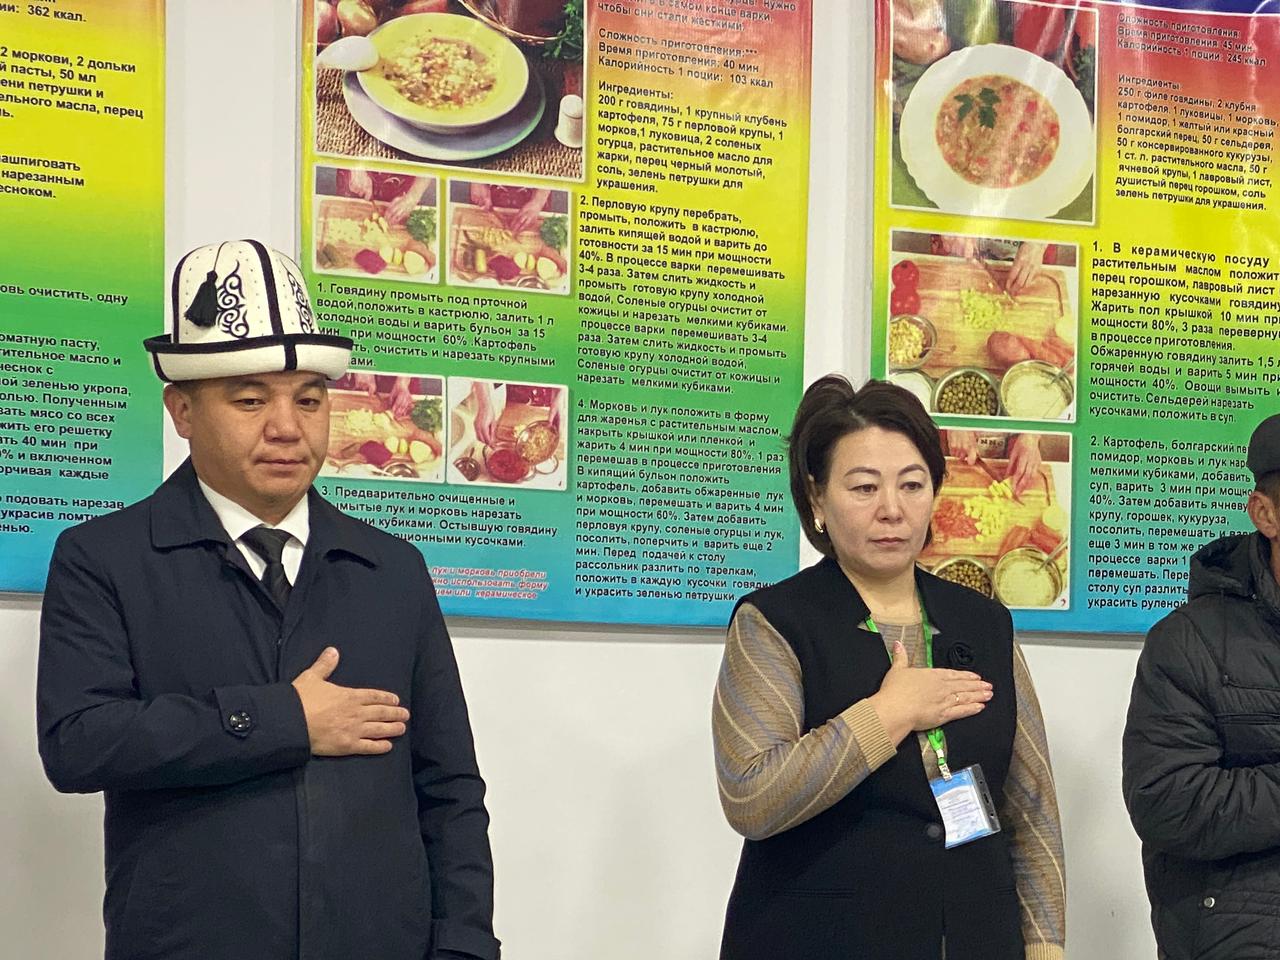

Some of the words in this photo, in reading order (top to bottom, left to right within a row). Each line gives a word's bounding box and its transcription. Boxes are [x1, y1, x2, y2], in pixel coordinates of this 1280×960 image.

[26, 6, 50, 18] 362
[52, 10, 87, 22] ккал.
[0, 47, 8, 57] 2
[11, 50, 73, 67] моркови,
[75, 56, 85, 67] 2
[86, 59, 136, 73] дольки
[10, 65, 56, 79] пасты,
[58, 69, 75, 80] 50
[77, 73, 96, 82] мл
[27, 82, 92, 97] петрушки
[95, 90, 104, 98] и
[598, 80, 673, 99] Ингредиенты:
[55, 100, 100, 114] масла,
[103, 106, 144, 119] перец
[597, 94, 616, 107] 200
[618, 99, 624, 108] г
[625, 100, 683, 116] говядины,
[685, 105, 691, 116] 1
[743, 114, 788, 127] клубень
[597, 110, 659, 126] картофеля,
[662, 115, 675, 127] 75
[676, 119, 682, 128] г
[683, 120, 737, 134] перловой
[738, 127, 775, 141] крупы,
[778, 130, 783, 140] 1
[647, 129, 703, 145] луковица,
[704, 134, 712, 145] 2
[714, 137, 762, 151] соленых
[596, 137, 636, 151] огурца,
[638, 142, 714, 159] растительное
[716, 151, 750, 163] масло
[751, 155, 773, 165] для
[634, 155, 668, 168] перец
[714, 164, 765, 180] молотый,
[1, 170, 84, 186] нарезанным
[596, 165, 625, 177] соль,
[627, 168, 666, 180] зелень
[668, 172, 720, 186] петрушки
[721, 178, 743, 189] для
[596, 178, 658, 193] украшения.
[1092, 240, 1103, 252] 1.
[1112, 242, 1121, 253] В
[1130, 246, 1216, 263] керамическую
[1224, 253, 1270, 268] посуду
[1091, 258, 1177, 273] растительным
[1184, 265, 1221, 276] маслом
[1091, 272, 1126, 285] перец
[1128, 275, 1189, 290] горошком,
[1191, 280, 1243, 293] лавровый
[1246, 284, 1276, 295] лист
[27, 287, 93, 302] очистить,
[96, 293, 128, 305] одну
[316, 282, 327, 293] 1.
[329, 283, 387, 300] Говядину
[389, 290, 444, 302] промыть
[446, 294, 470, 306] под
[1091, 287, 1160, 303] нарезанную
[1169, 293, 1221, 305] кусочками
[68, 353, 110, 364] масло
[112, 357, 121, 365] и
[20, 379, 80, 391] зеленью
[42, 393, 127, 409] Полученным
[29, 409, 64, 419] мясо
[66, 411, 83, 420] со
[85, 412, 115, 422] всех
[589, 399, 638, 413] Морковь
[640, 404, 647, 413] и
[649, 406, 668, 415] лук
[671, 407, 722, 418] положить
[724, 410, 731, 419] в
[732, 411, 770, 424] форму
[33, 424, 56, 433] его
[58, 425, 113, 439] решетку
[20, 436, 37, 446] 40
[40, 439, 67, 448] мин
[73, 440, 98, 451] при
[1089, 435, 1100, 446] 2.
[1103, 436, 1168, 450] Картофель,
[1171, 440, 1235, 454] болгарский
[17, 452, 26, 460] и
[29, 452, 112, 465] включенном
[1089, 466, 1140, 477] мелкими
[1142, 468, 1198, 482] кубиками,
[1201, 472, 1251, 484] добавить
[71, 498, 125, 509] нарезав
[1088, 510, 1123, 523] крупу,
[1126, 512, 1175, 524] горошек,
[1177, 513, 1230, 526] кукуруза,
[575, 560, 639, 571] рассольник
[641, 563, 685, 573] разлить
[686, 564, 700, 573] по
[705, 565, 757, 577] тарелкам,
[1087, 598, 1138, 609] украсить
